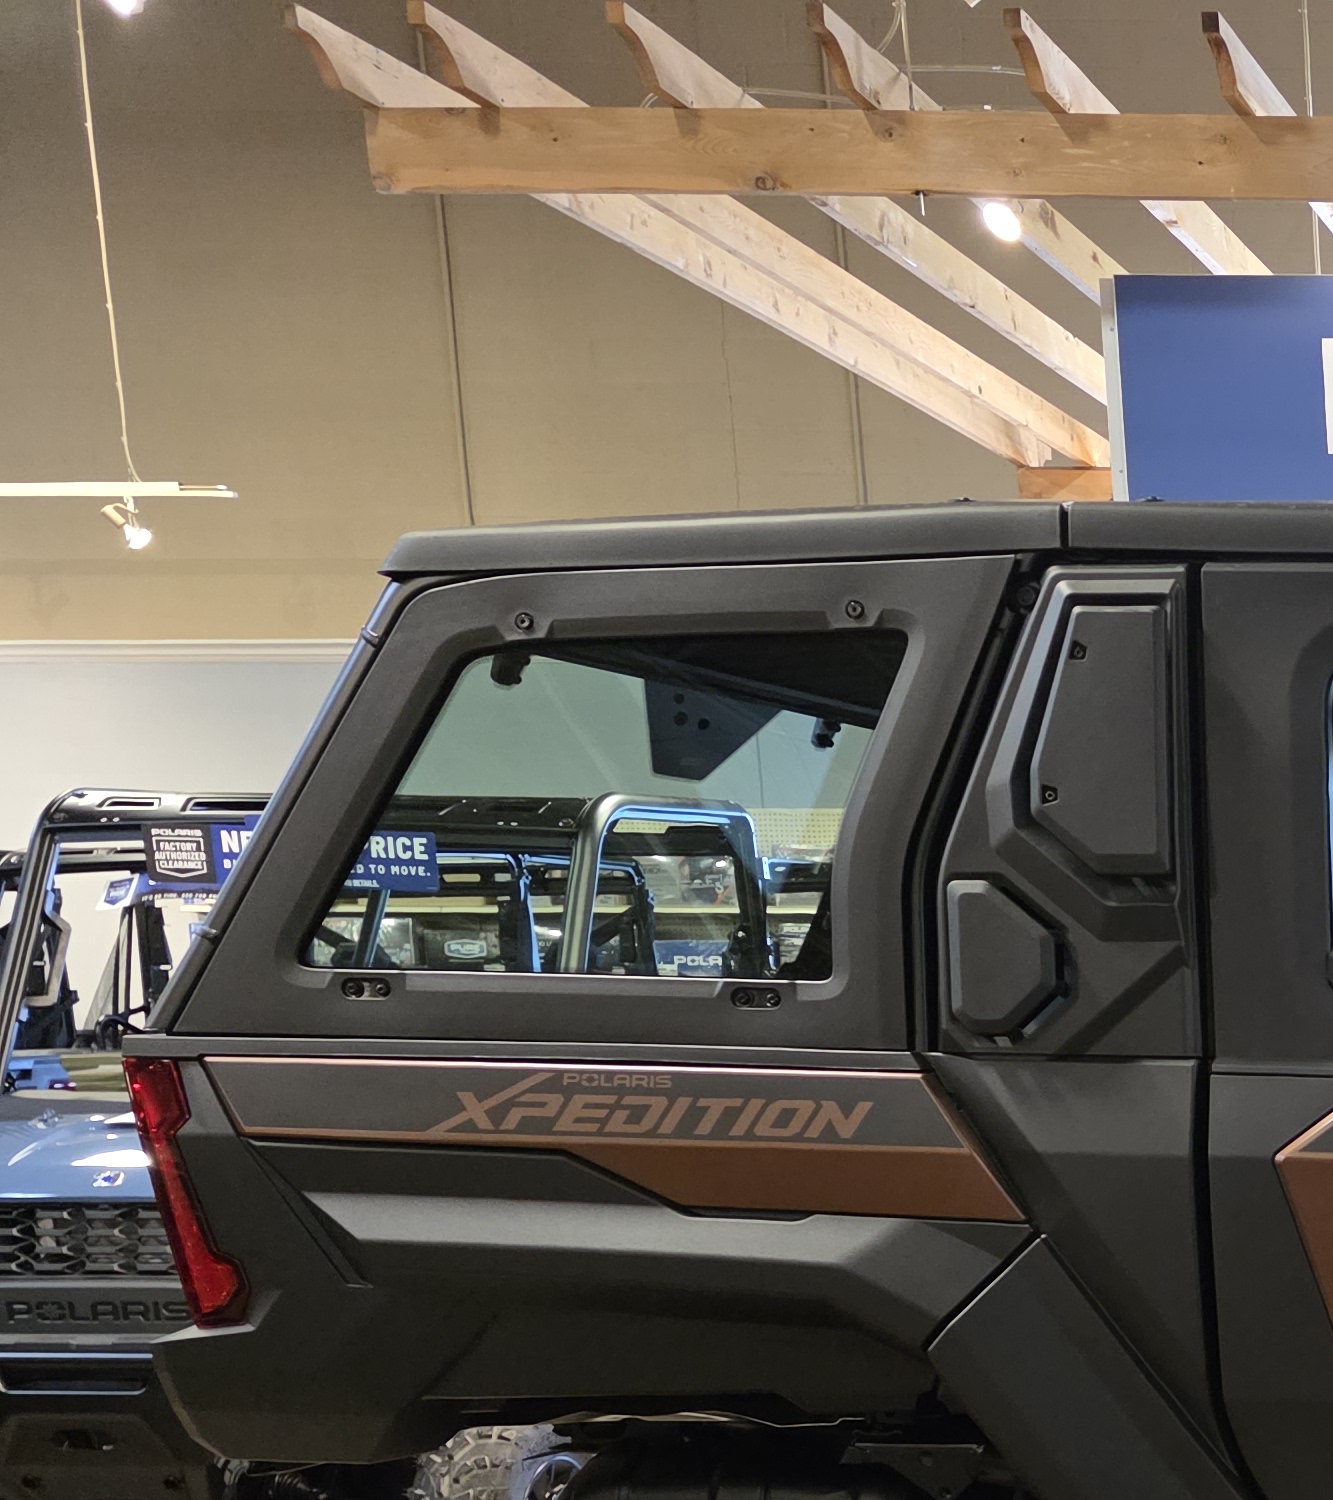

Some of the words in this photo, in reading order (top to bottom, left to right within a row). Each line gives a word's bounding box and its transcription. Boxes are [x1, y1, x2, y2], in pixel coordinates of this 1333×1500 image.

[151, 828, 203, 836] POLARIS
[160, 841, 198, 851] FACTORY
[364, 835, 429, 860] RICE
[154, 851, 207, 861] AUTHORIZED
[159, 860, 203, 869] CLEARANCE
[368, 864, 386, 875] TO
[390, 865, 431, 876] MOVE.
[562, 1072, 673, 1089] POLARIS
[424, 1073, 874, 1139] XPEDITION
[5, 1301, 194, 1323] POLARIS
